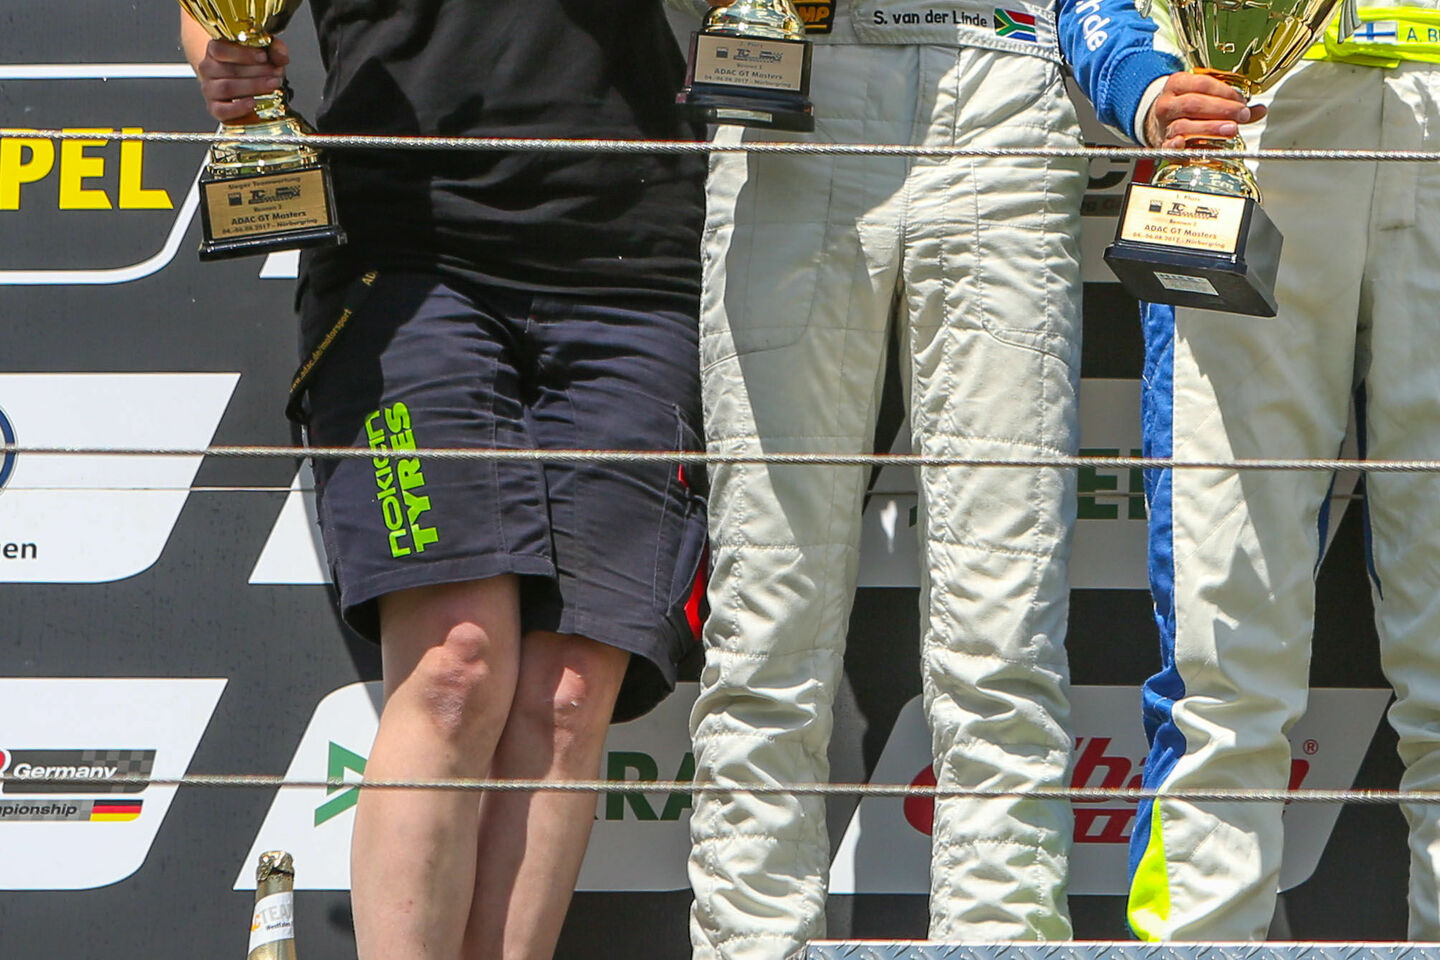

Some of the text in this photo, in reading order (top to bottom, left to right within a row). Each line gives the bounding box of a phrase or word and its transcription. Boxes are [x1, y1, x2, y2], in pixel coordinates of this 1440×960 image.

[873, 9, 988, 27] S. van der Linde
[1406, 28, 1424, 43] A.
[231, 209, 307, 225] ADAC GT Masters
[1144, 224, 1169, 234] ADAC
[1184, 229, 1218, 240] Masters
[364, 409, 412, 559] nokian
[384, 401, 440, 553] TYRES
[13, 763, 118, 780] Germany
